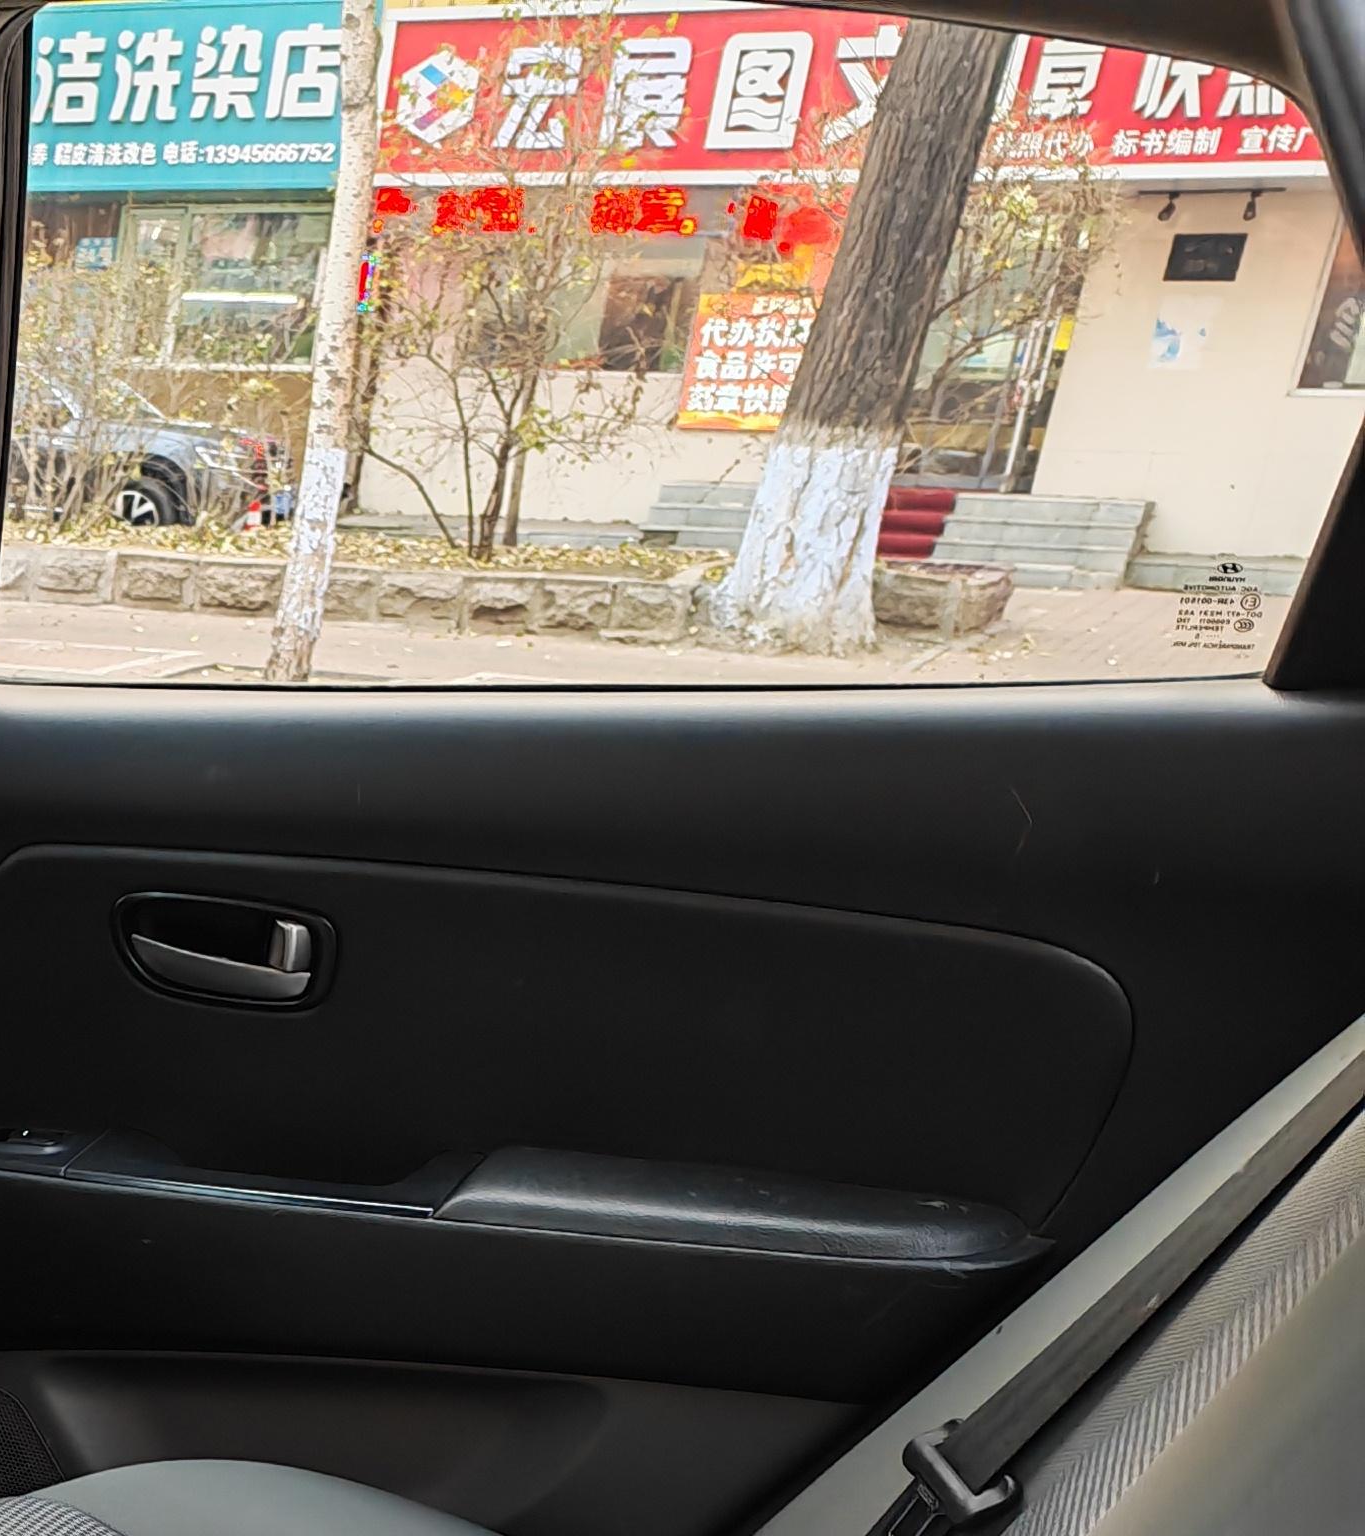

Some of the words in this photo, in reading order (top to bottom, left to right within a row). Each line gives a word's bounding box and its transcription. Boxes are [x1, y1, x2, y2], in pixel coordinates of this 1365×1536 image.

[31, 24, 342, 124] 洁洗染店
[1111, 126, 1223, 158] 标书编制
